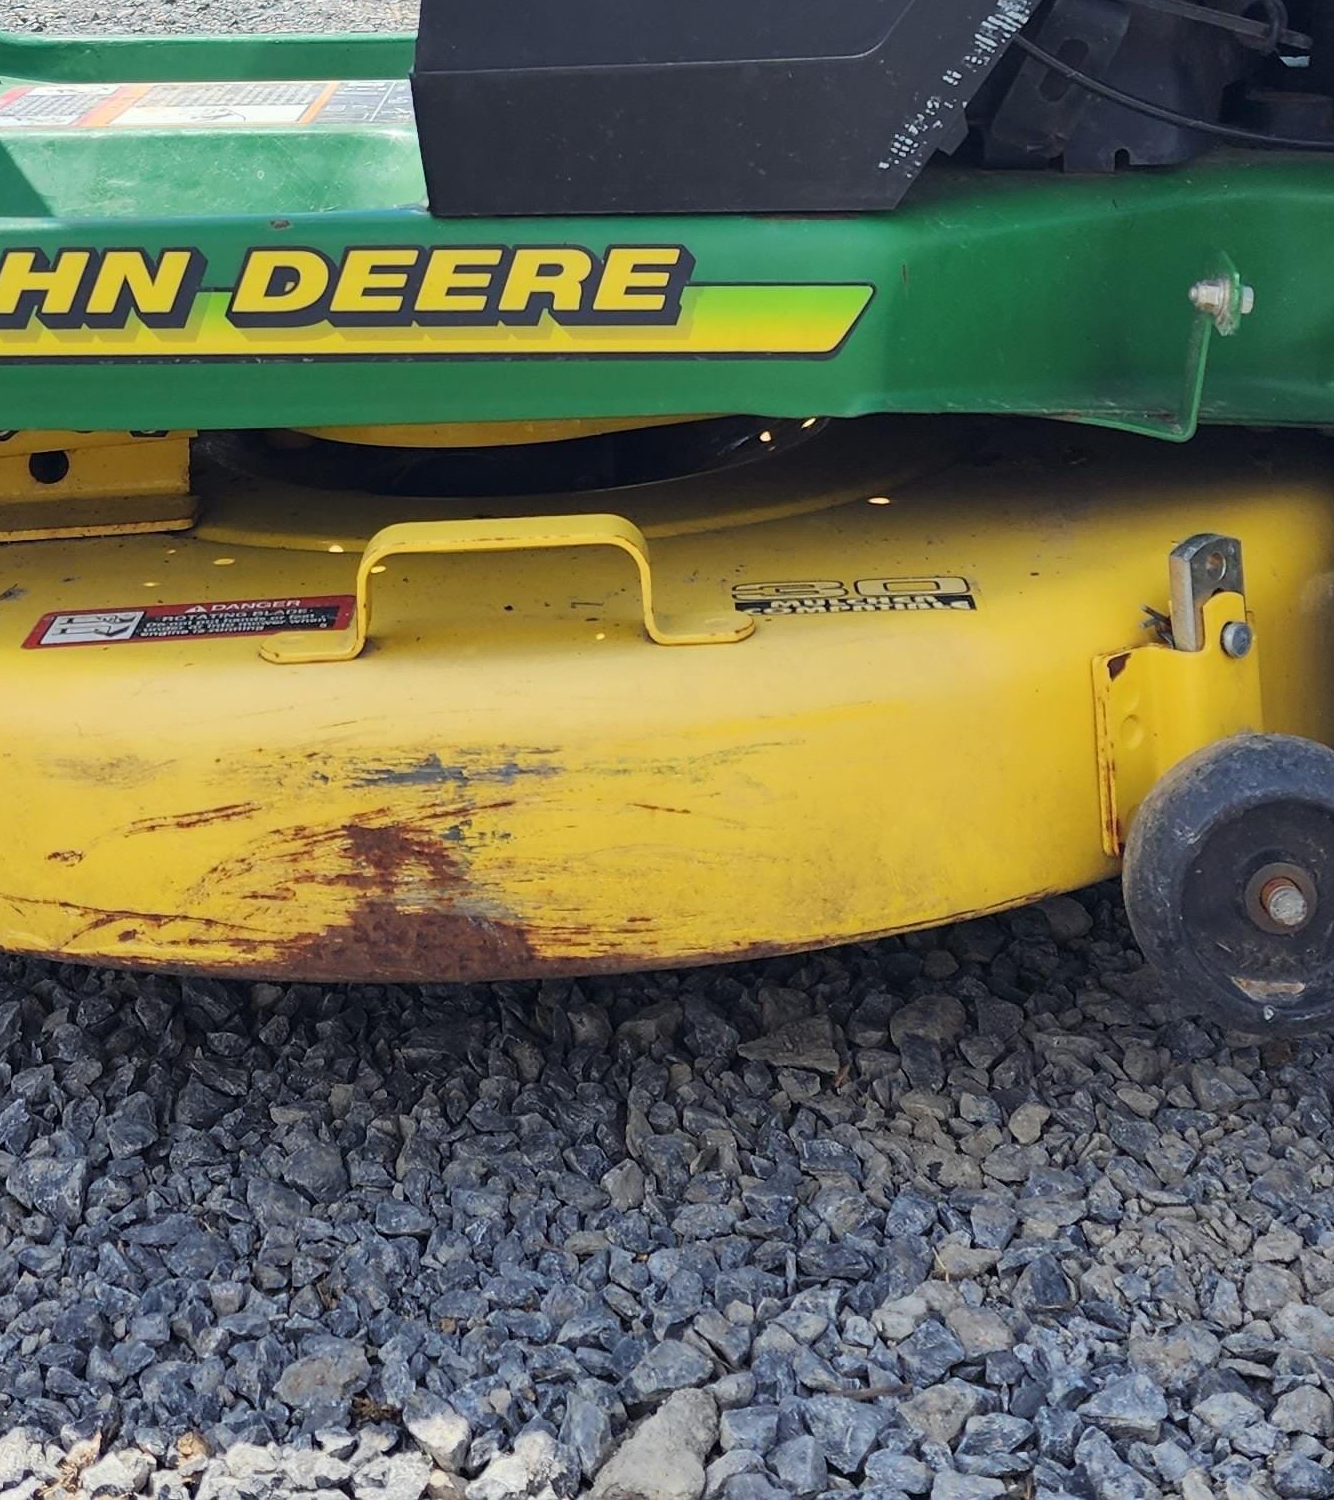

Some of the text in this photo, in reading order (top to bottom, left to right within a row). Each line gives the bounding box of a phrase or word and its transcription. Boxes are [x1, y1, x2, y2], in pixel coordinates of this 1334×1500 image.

[227, 244, 695, 327] DEERE
[210, 600, 301, 612] DANGER
[162, 611, 247, 622] ROTATING
